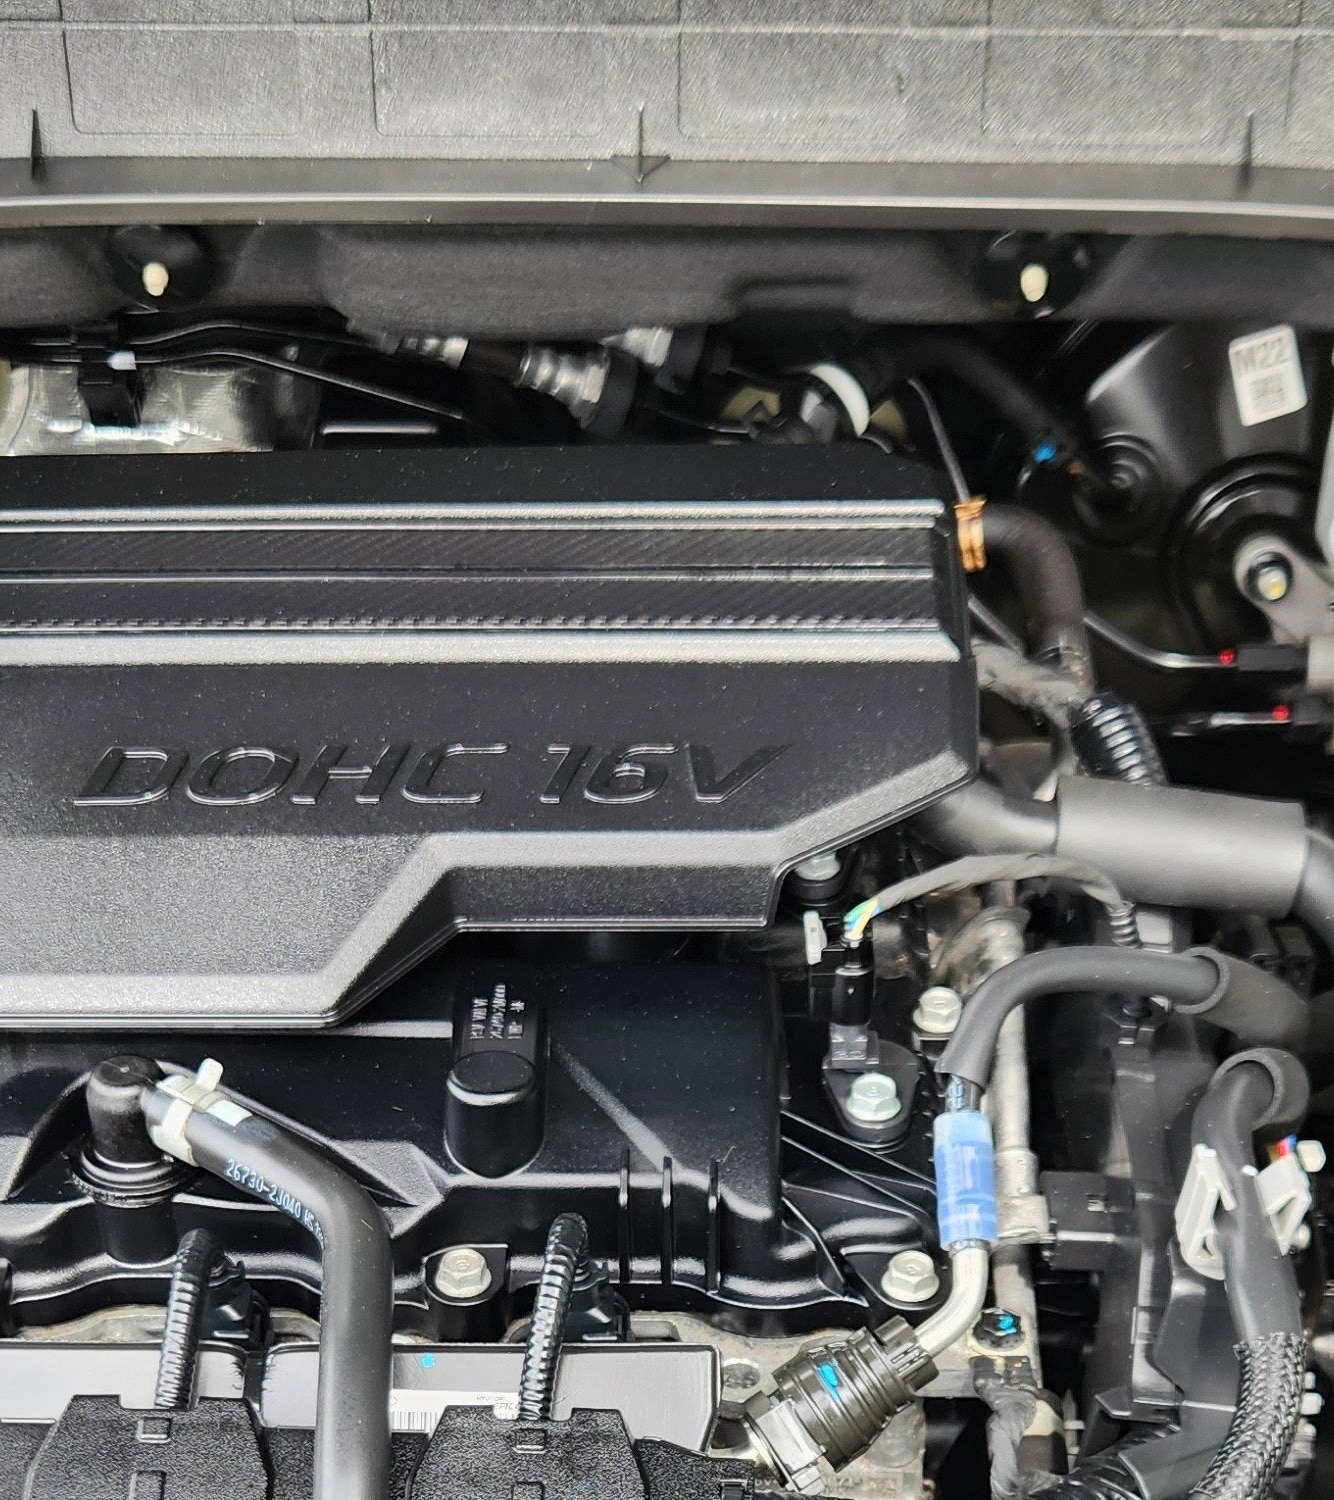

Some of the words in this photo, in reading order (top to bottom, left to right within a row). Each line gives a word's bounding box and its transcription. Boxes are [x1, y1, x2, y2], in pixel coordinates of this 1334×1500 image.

[74, 742, 509, 807] DOHC
[539, 741, 792, 805] 16V
[225, 1158, 304, 1220] 26730-2J040
